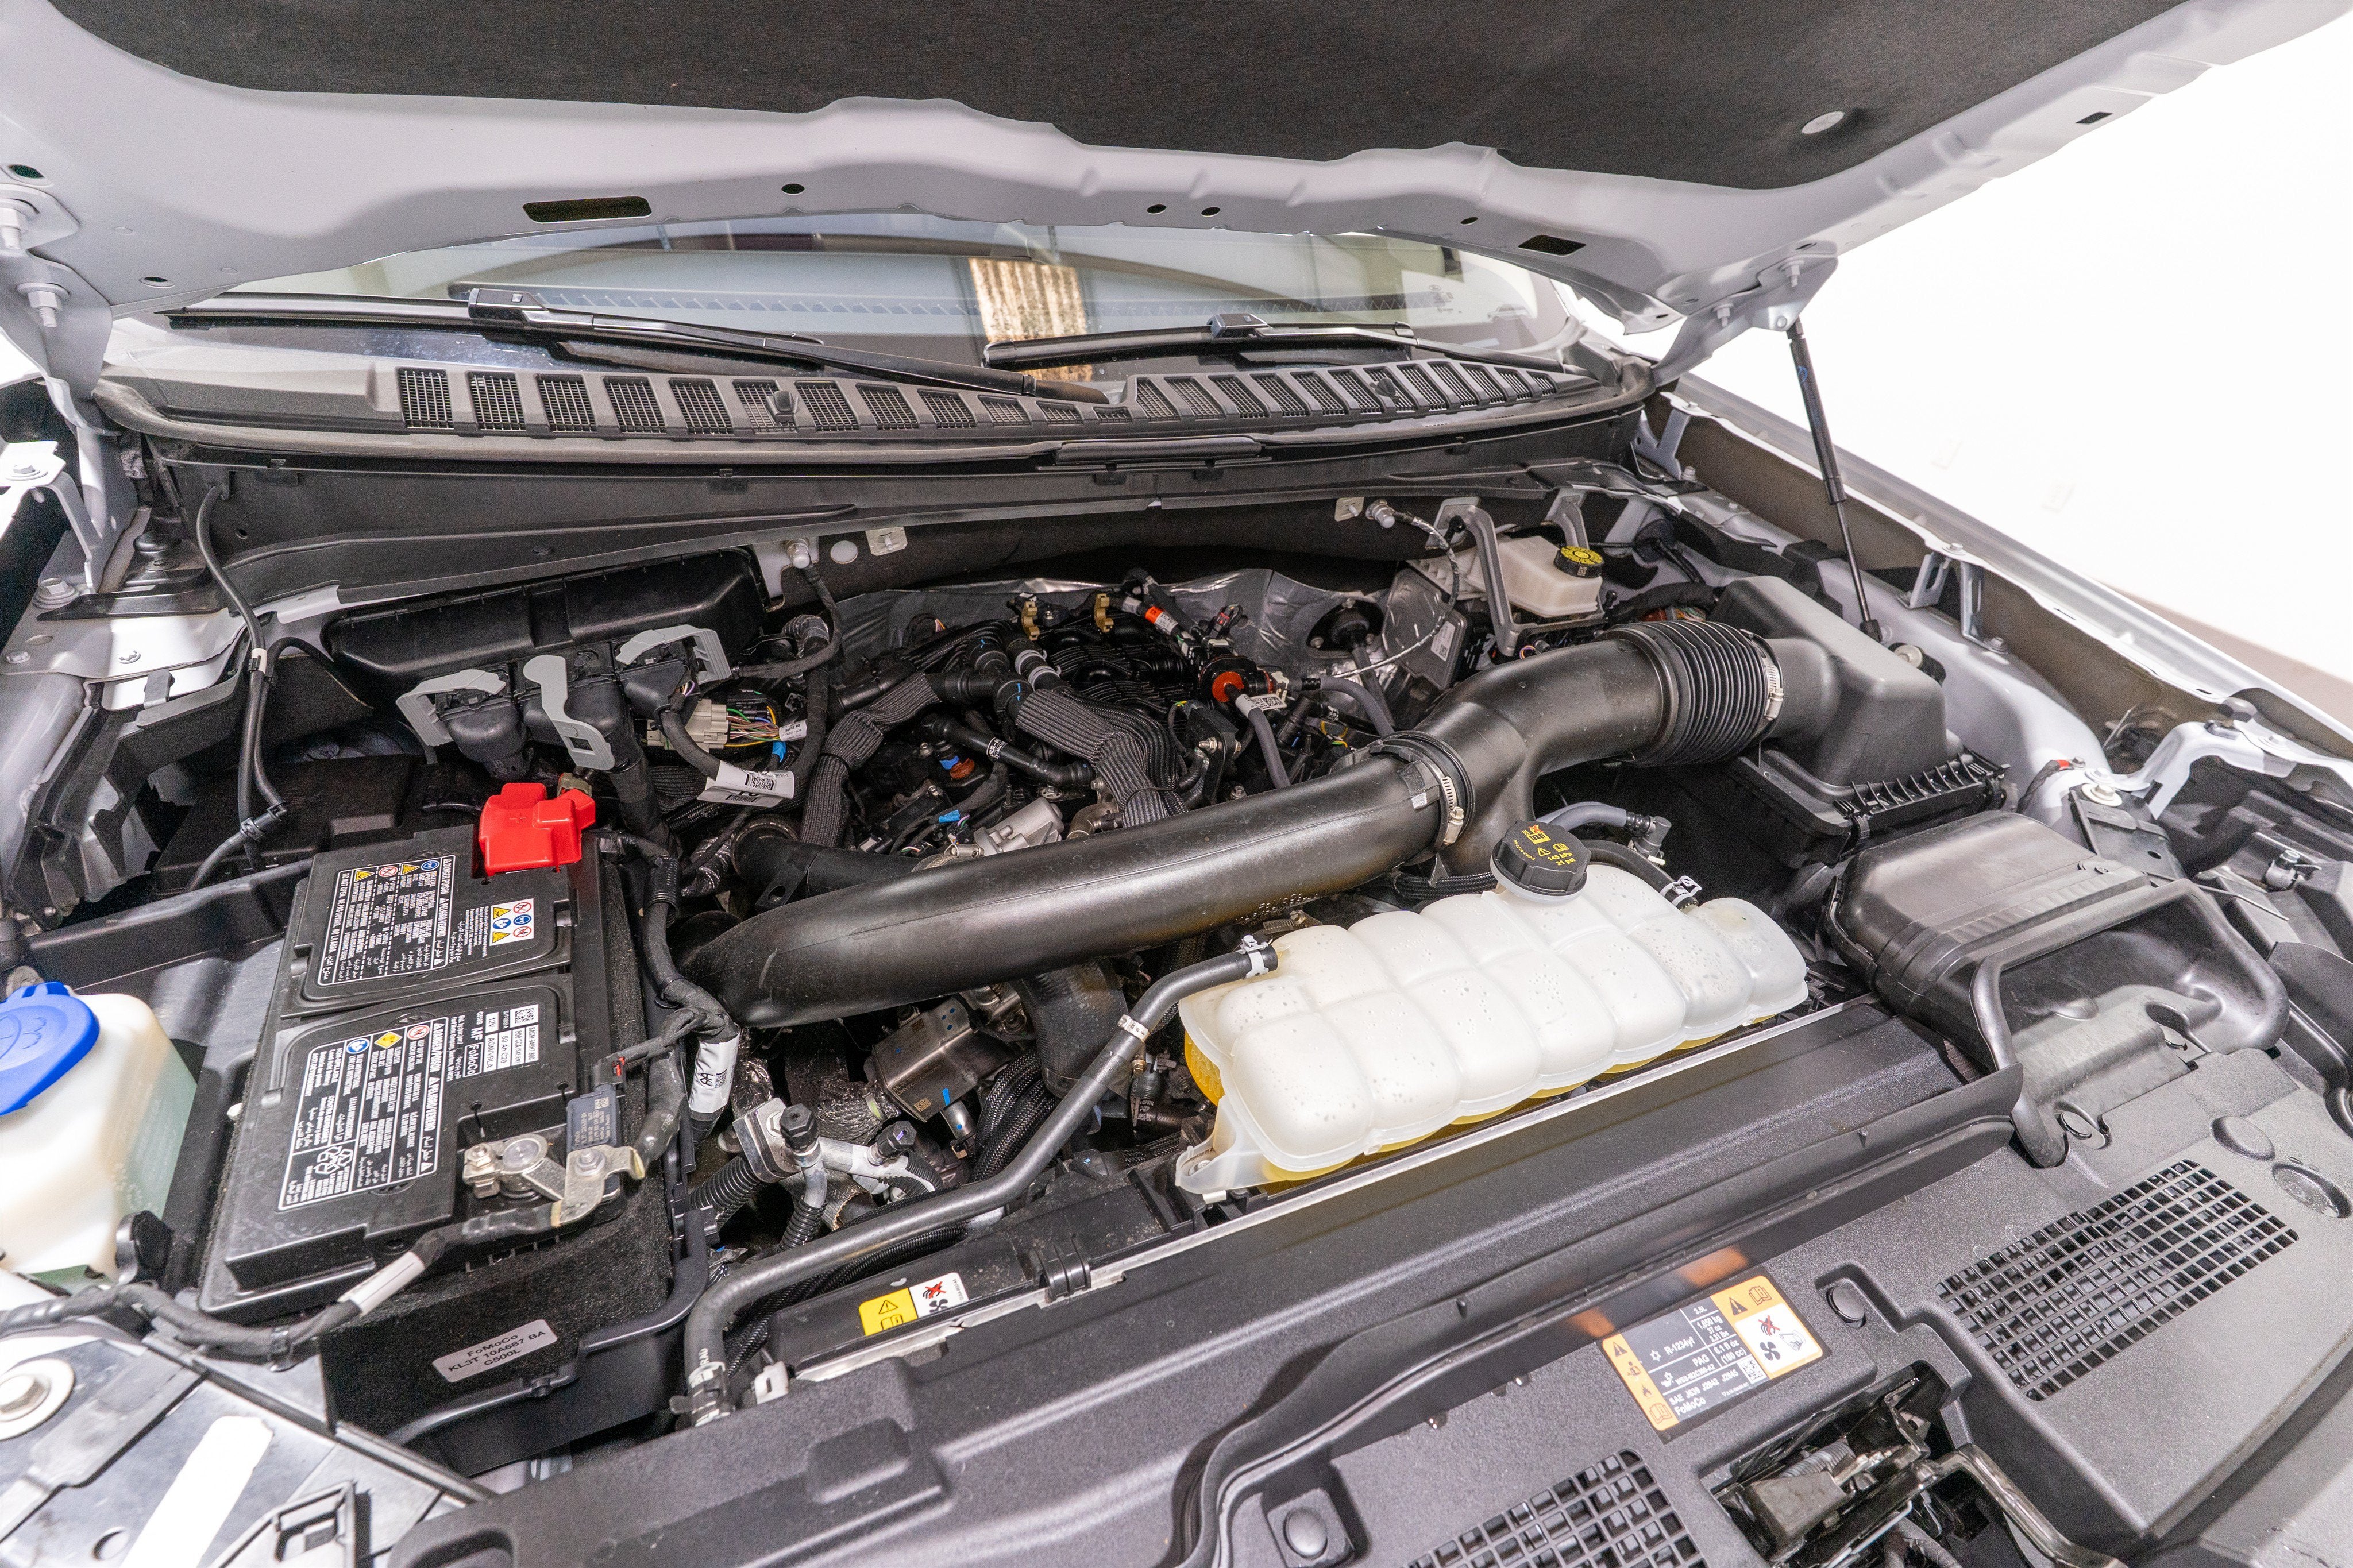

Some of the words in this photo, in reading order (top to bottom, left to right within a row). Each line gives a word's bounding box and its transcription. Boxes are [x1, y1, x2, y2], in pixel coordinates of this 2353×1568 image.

[340, 878, 349, 886] NOT
[440, 863, 451, 894] DANGER/POISON
[338, 886, 348, 898] OPEN.
[335, 904, 344, 912] PAS
[333, 912, 343, 928] OUVRIR.
[437, 902, 448, 937] PELIGRO/VENENO
[328, 941, 338, 954] ABRA.
[488, 1017, 496, 1027] 12V
[470, 1026, 483, 1040] MF
[430, 1029, 443, 1072] DANGER/POISON
[501, 1044, 508, 1052] Ah
[514, 1038, 522, 1048] CCA
[466, 1044, 479, 1075] FoMoCo
[486, 1037, 495, 1068] AGM/VRLA
[500, 1052, 508, 1063] C20
[424, 1083, 438, 1131] PELIGRO/VENENO
[1693, 1305, 1707, 1315] 3.5L
[1696, 1317, 1714, 1329] 1.050
[1711, 1315, 1723, 1323] kg
[1706, 1326, 1715, 1334] 37
[1708, 1333, 1721, 1342] 2.31
[448, 1357, 481, 1372] KL3T
[484, 1339, 524, 1358] 10A687
[528, 1331, 546, 1341] BA
[467, 1335, 518, 1357] FoMoCo
[1664, 1336, 1695, 1355] R-1234yf
[1713, 1344, 1725, 1354] 6.1
[1723, 1342, 1731, 1350] fl
[1730, 1339, 1739, 1347] oz
[484, 1349, 522, 1366] C500L
[1692, 1354, 1710, 1366] PAG
[1720, 1351, 1735, 1365] (180
[1734, 1346, 1747, 1357] cc)
[1669, 1393, 1684, 1405] SAE
[1685, 1386, 1700, 1398] J639
[1702, 1378, 1719, 1391] J2842
[1674, 1397, 1706, 1415] FoMoCo
